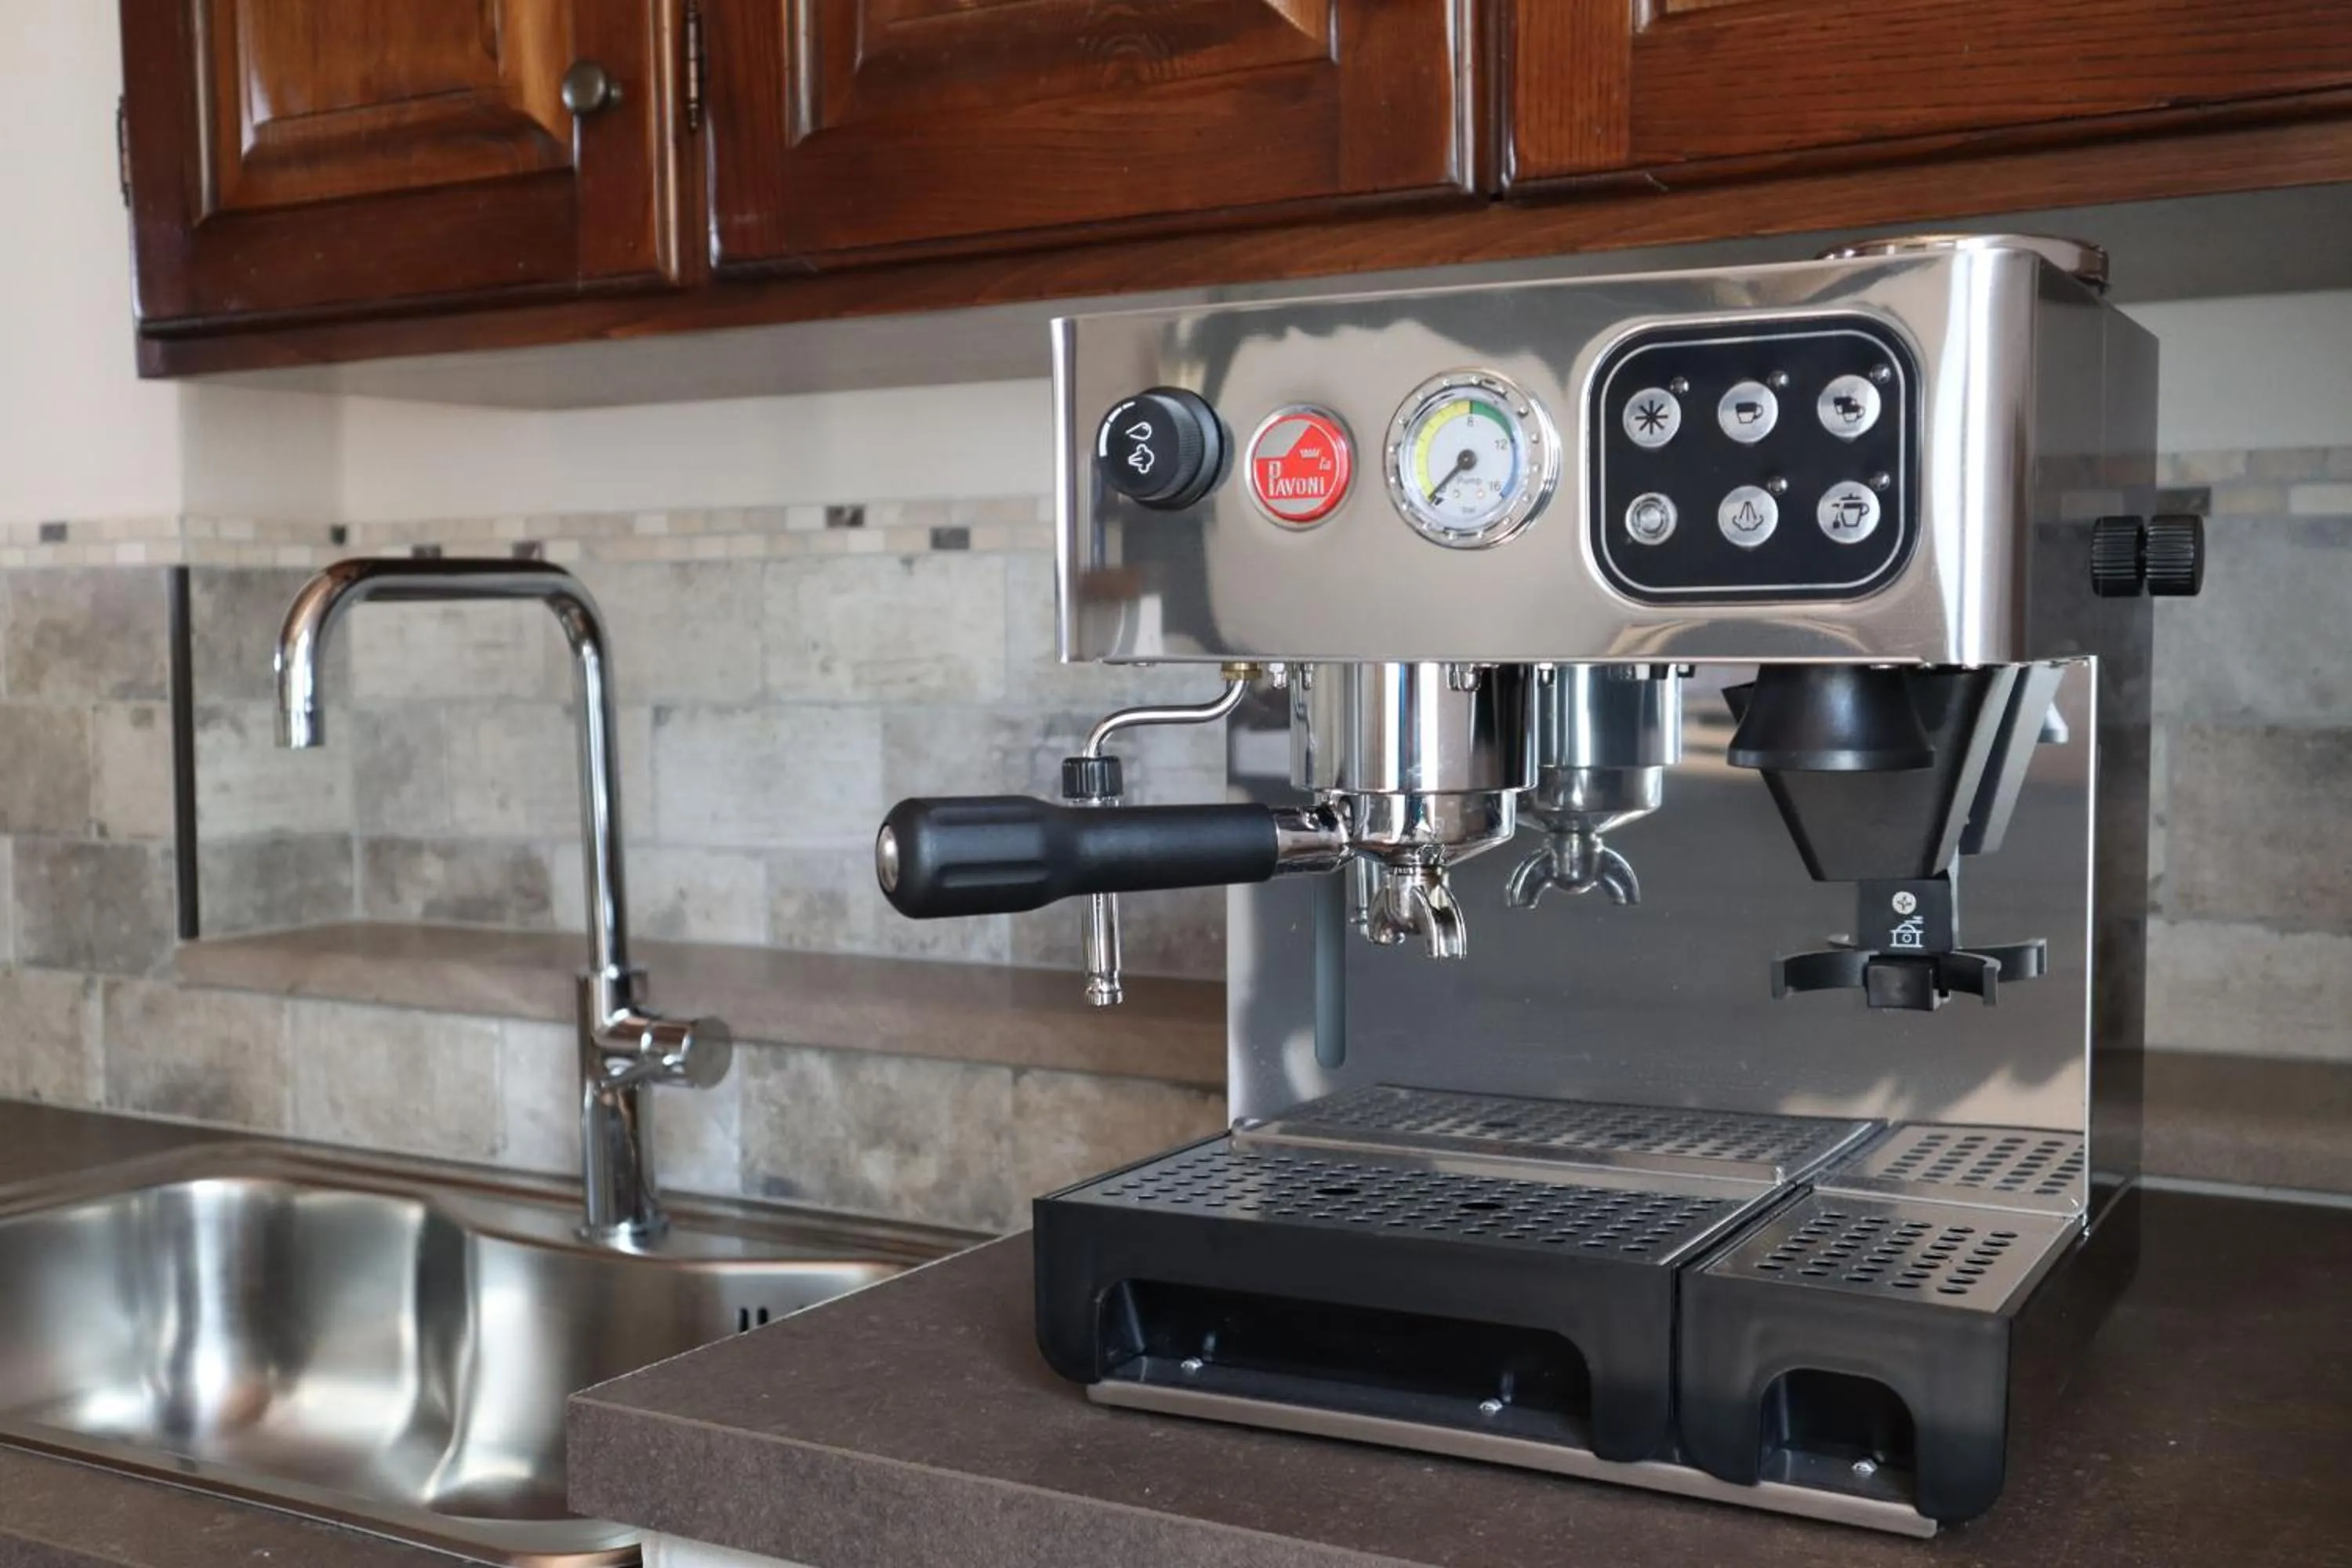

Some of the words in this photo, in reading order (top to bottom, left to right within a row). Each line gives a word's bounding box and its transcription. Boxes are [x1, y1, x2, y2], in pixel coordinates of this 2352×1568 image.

[1494, 439, 1508, 451] 12
[1269, 461, 1325, 496] PAVONI
[1489, 481, 1502, 491] 16
